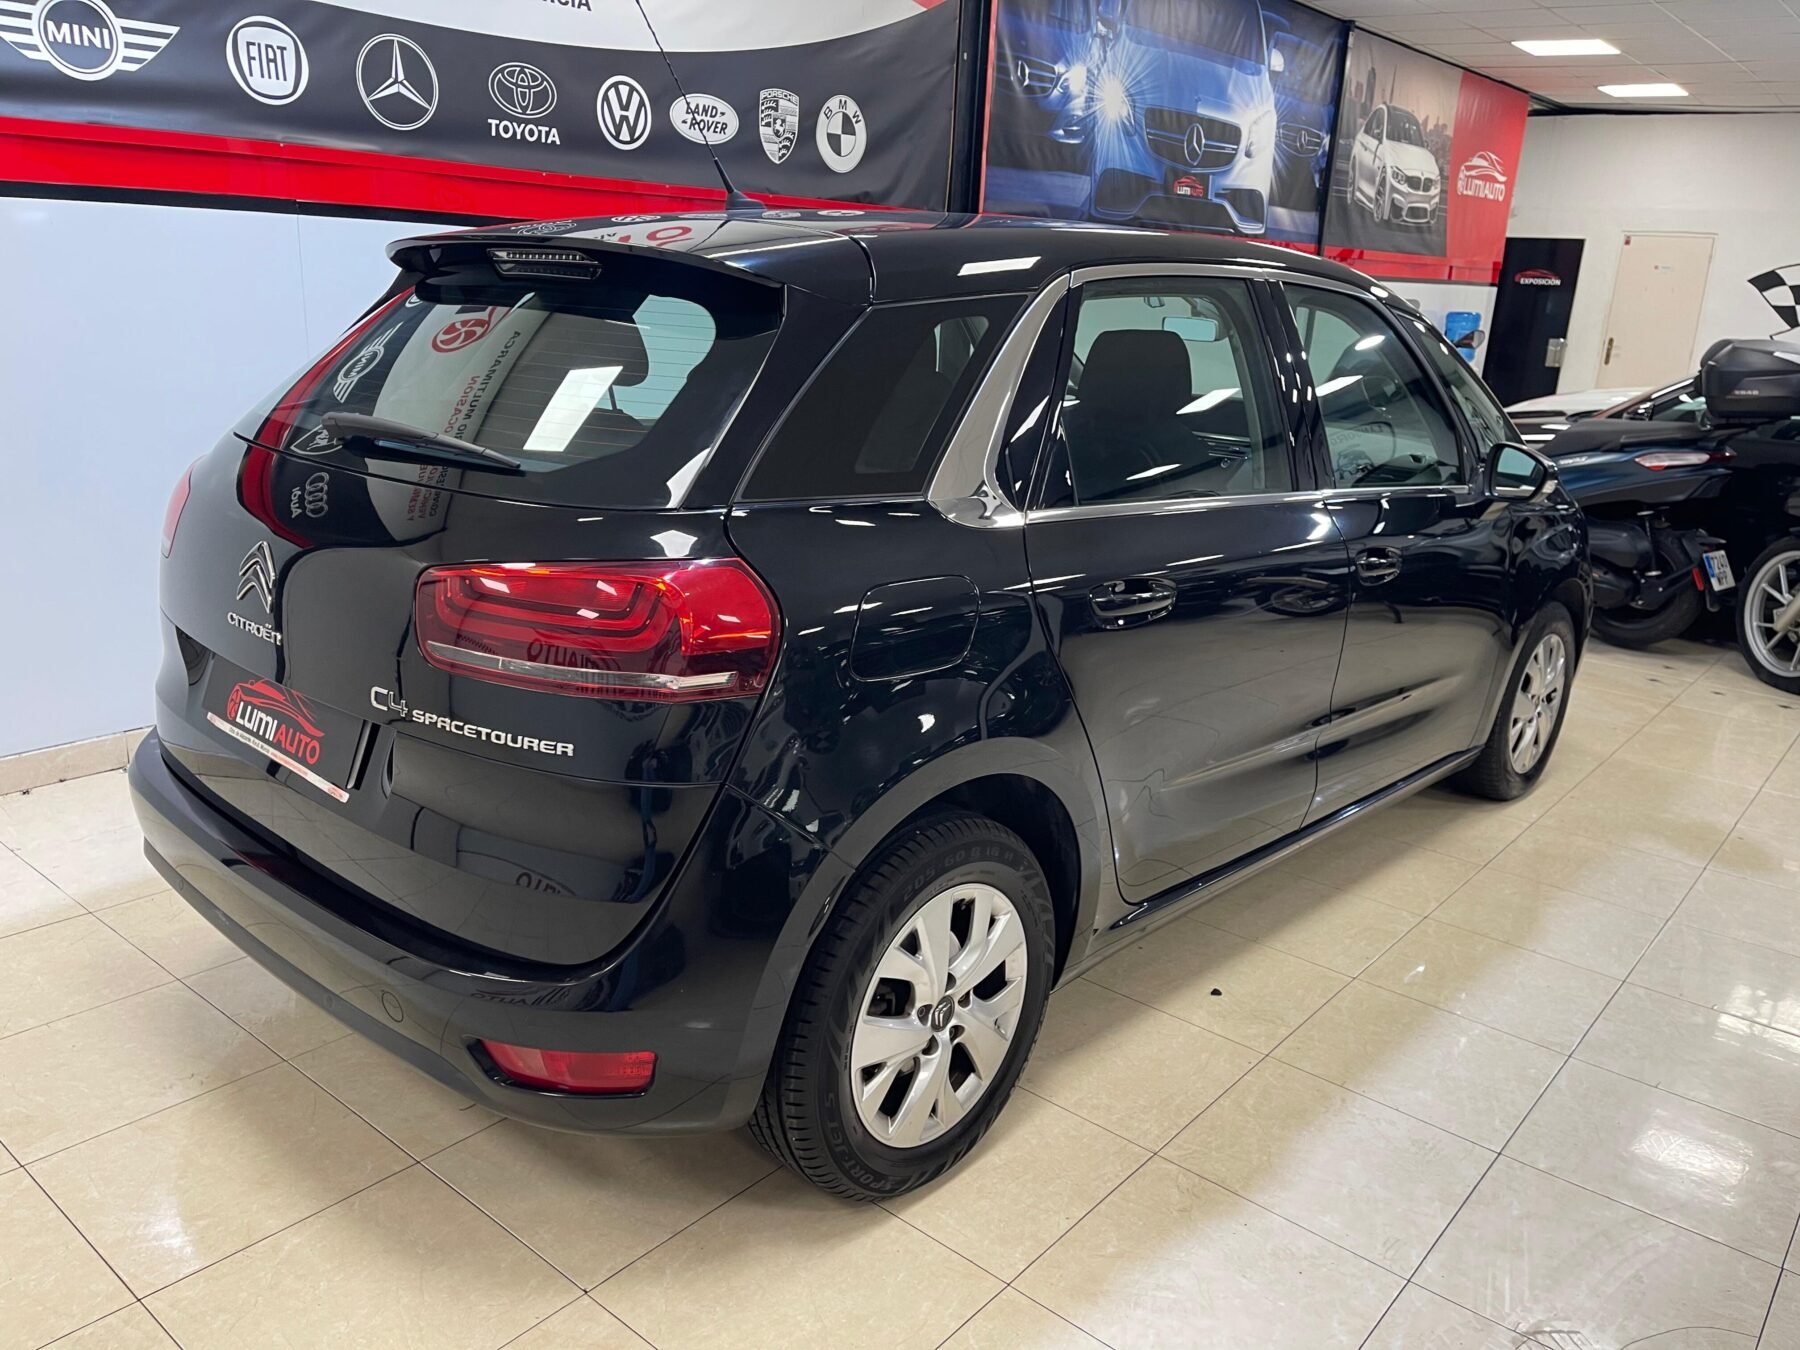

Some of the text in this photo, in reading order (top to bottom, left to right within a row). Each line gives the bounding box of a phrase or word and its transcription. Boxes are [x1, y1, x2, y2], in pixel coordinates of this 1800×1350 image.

[46, 20, 112, 50] MINI
[245, 41, 288, 82] FIAT
[823, 98, 862, 125] BMW
[487, 118, 561, 145] TOYOTA
[370, 686, 408, 718] C4
[235, 701, 321, 765] LUMIAUTO
[412, 709, 575, 758] SPACETOURER
